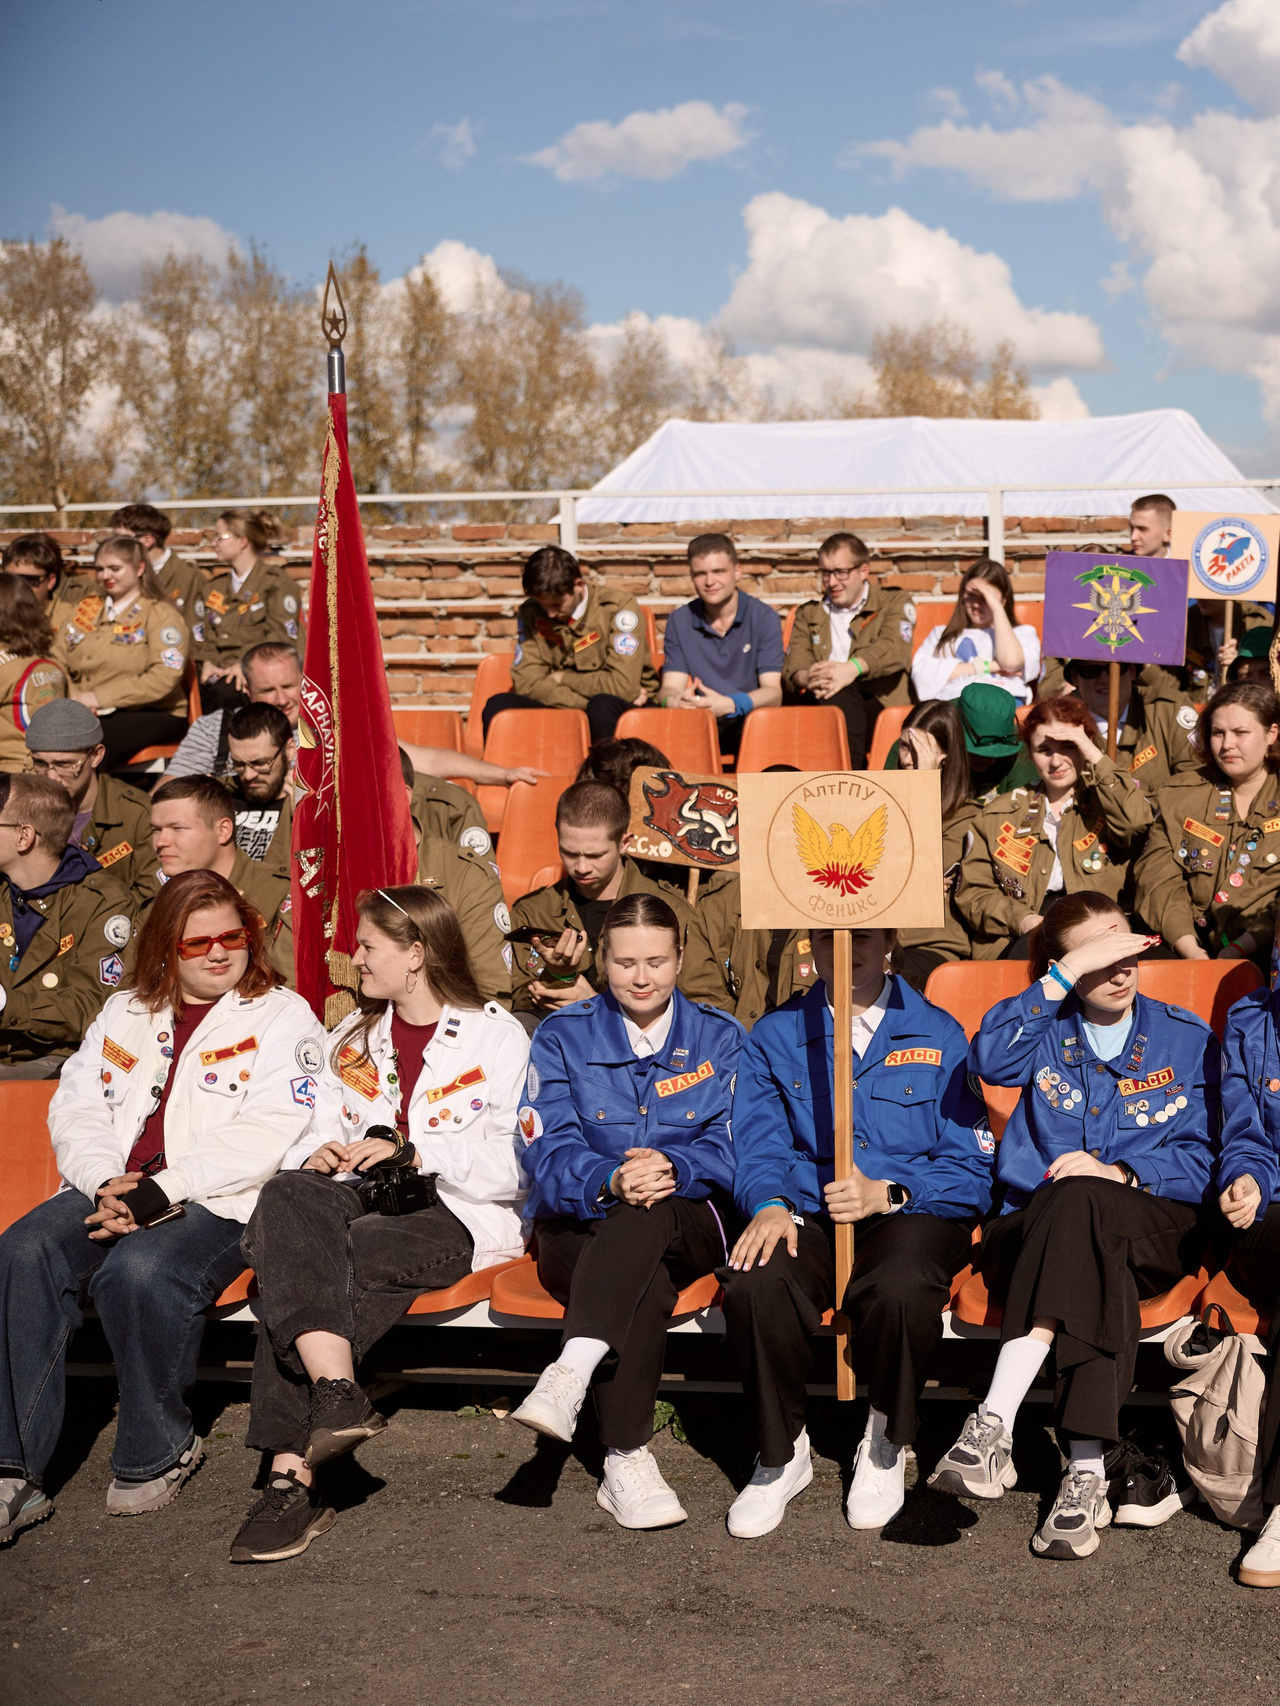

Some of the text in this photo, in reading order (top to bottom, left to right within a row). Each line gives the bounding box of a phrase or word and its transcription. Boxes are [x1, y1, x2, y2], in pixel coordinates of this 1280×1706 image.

[1225, 554, 1255, 583] РАКЕТА
[301, 678, 334, 765] БАРНАУЛ
[803, 781, 876, 803] АлтГПУ
[808, 893, 878, 919] Феникс
